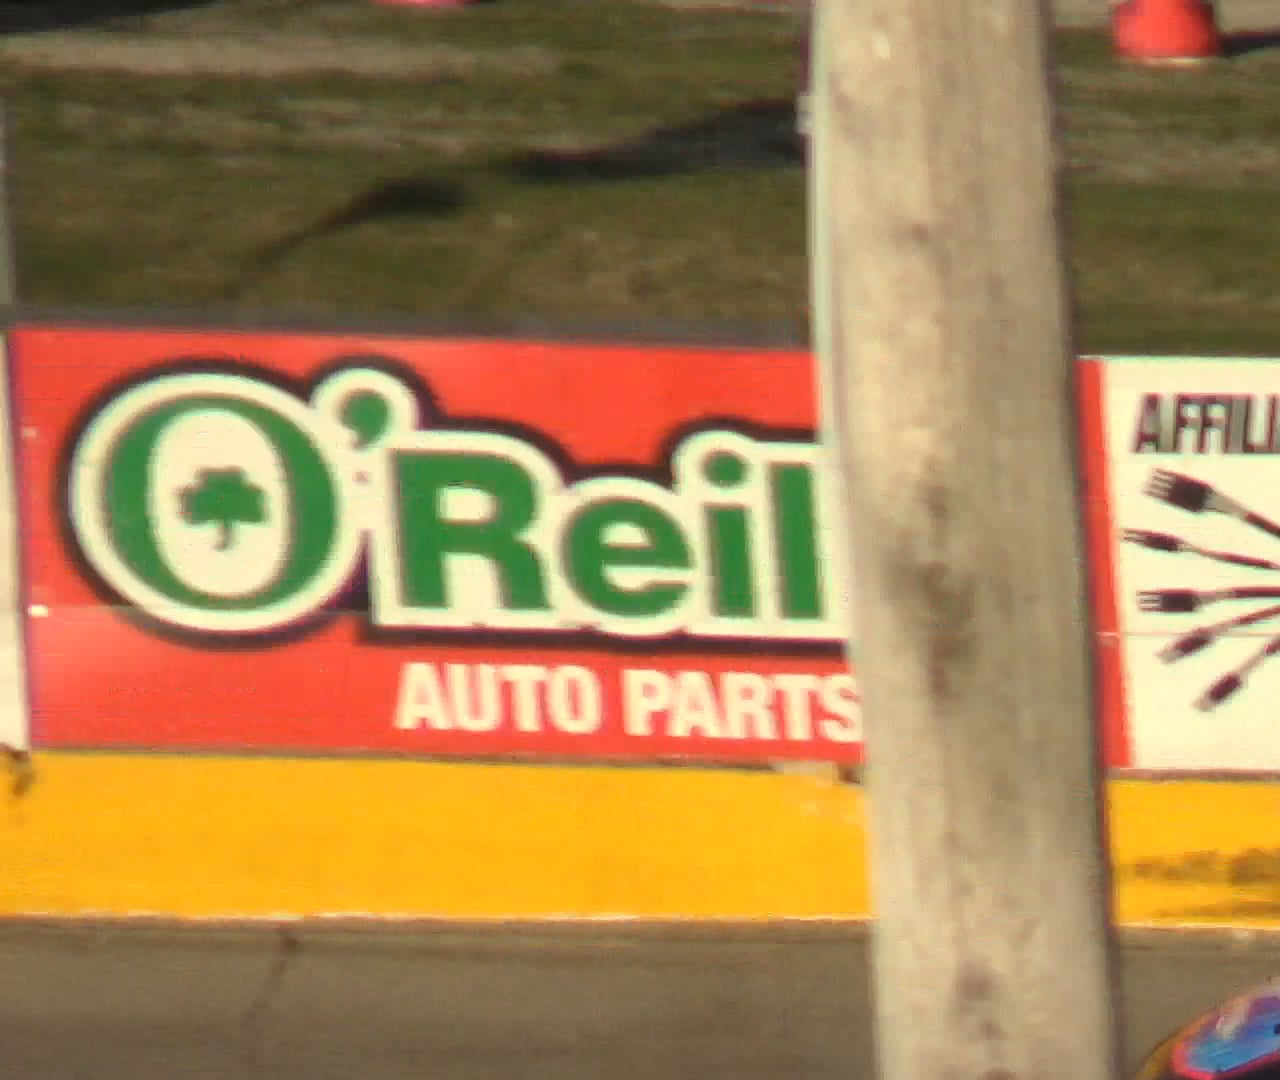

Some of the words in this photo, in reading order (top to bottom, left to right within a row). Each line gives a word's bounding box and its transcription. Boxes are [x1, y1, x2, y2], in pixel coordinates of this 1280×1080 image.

[70, 366, 840, 634] O'Reil
[395, 662, 600, 733] AUTO
[624, 669, 863, 742] PARTS
